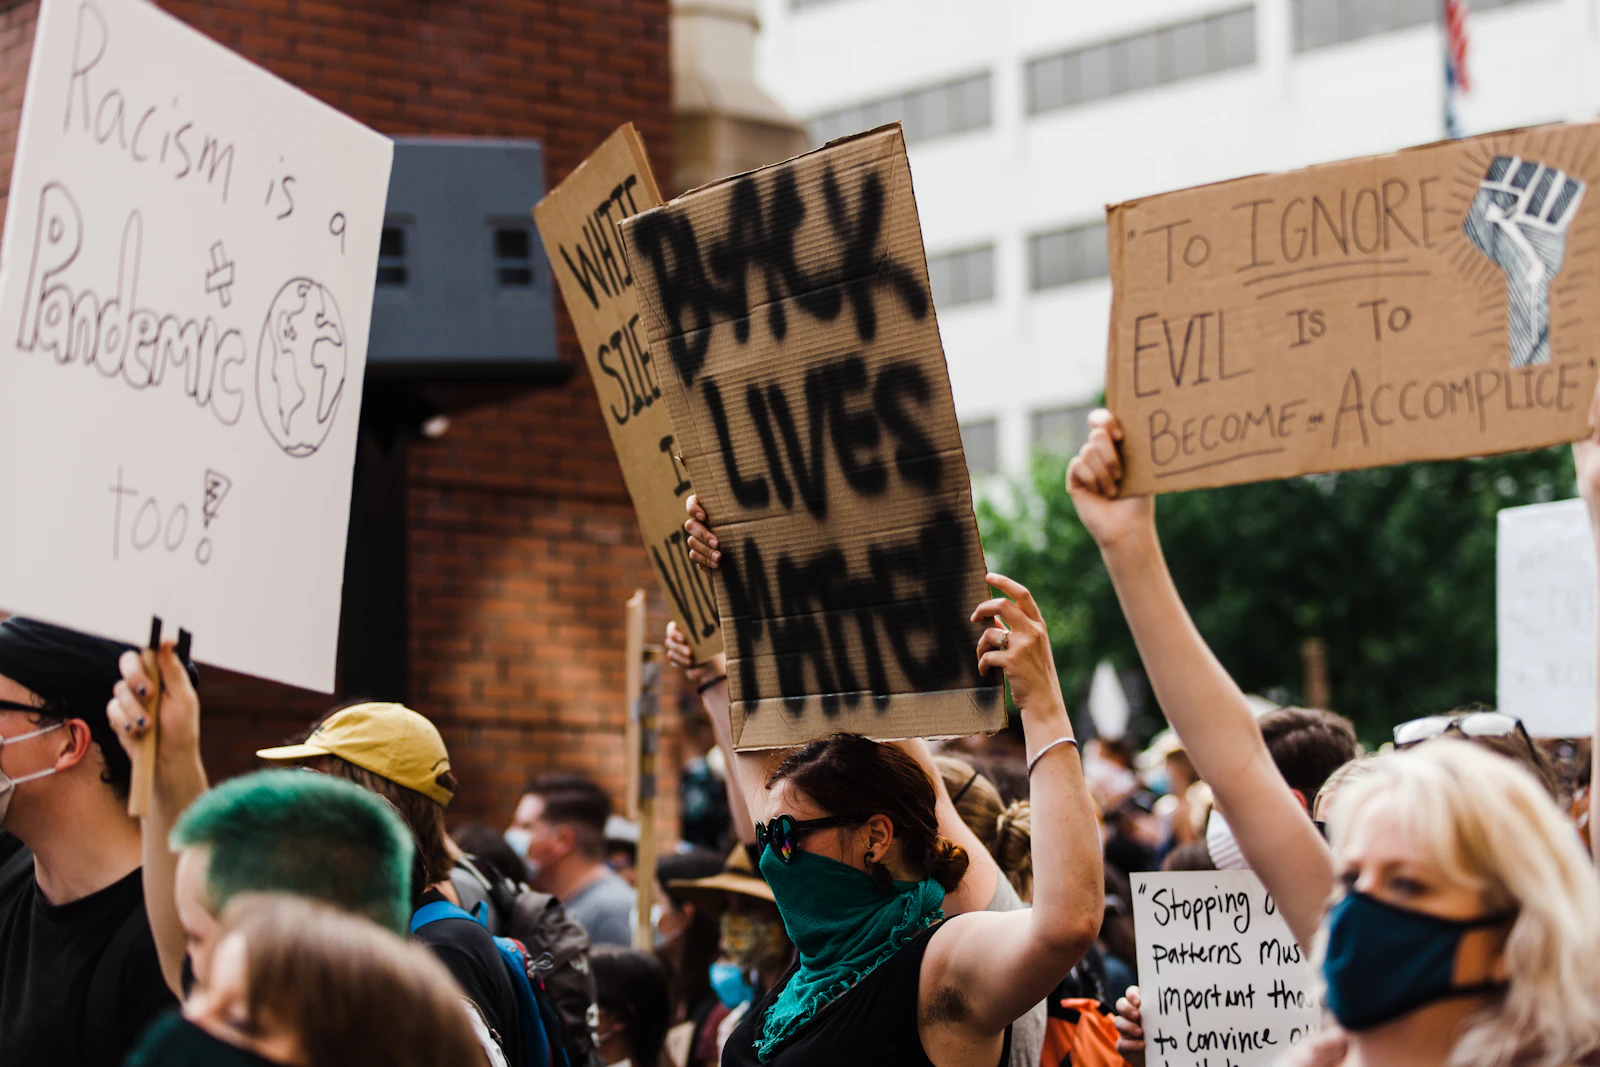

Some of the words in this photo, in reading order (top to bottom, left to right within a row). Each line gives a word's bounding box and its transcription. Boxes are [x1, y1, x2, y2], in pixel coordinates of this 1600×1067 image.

[64, 3, 235, 203] Racism
[265, 156, 297, 219] is
[632, 160, 929, 388] BLACK
[1231, 177, 1442, 274] IGNORE
[1134, 309, 1254, 398] EVIL
[702, 350, 944, 522] LIVES
[109, 465, 232, 565] too!
[716, 503, 1002, 718] MATTER
[1138, 883, 1250, 934] "Stopping
[1152, 942, 1242, 974] patterns
[1267, 979, 1313, 1010] tha
[1154, 1029, 1178, 1055] to
[1187, 1027, 1277, 1054] convince
